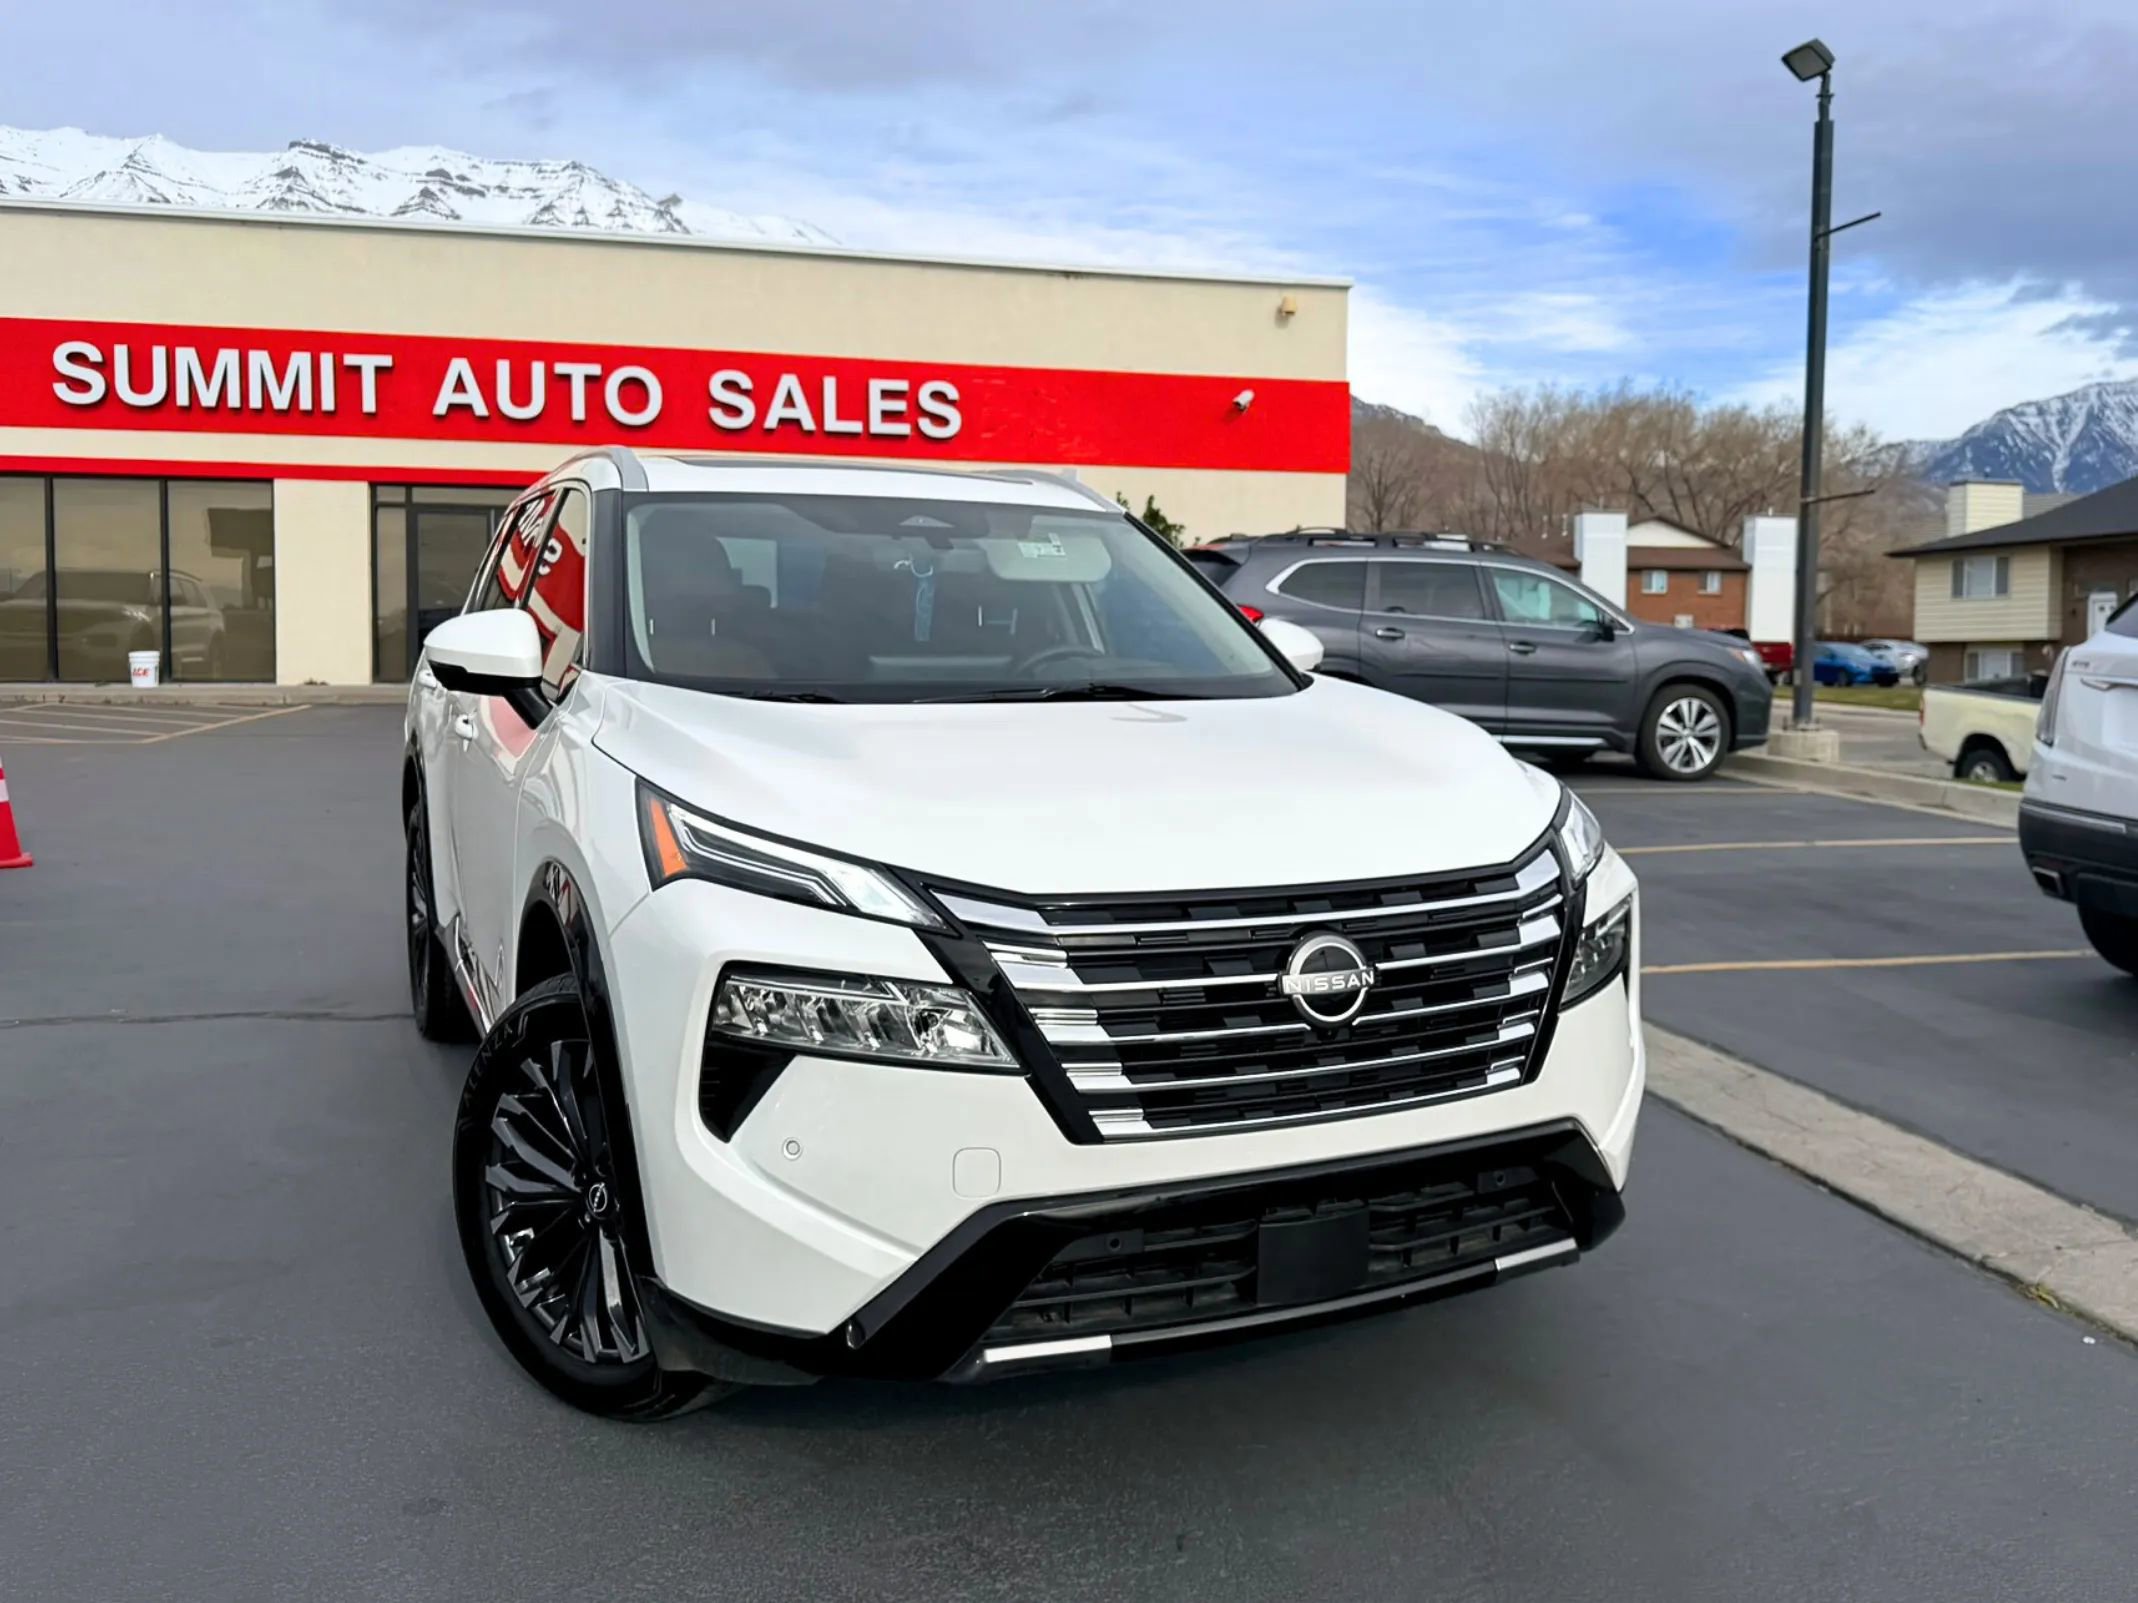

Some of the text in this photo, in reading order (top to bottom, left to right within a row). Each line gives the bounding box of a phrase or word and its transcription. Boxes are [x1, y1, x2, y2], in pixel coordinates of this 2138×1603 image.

[52, 341, 962, 439] SUMMIT AUTO SALES
[1284, 970, 1375, 993] NISSAN
